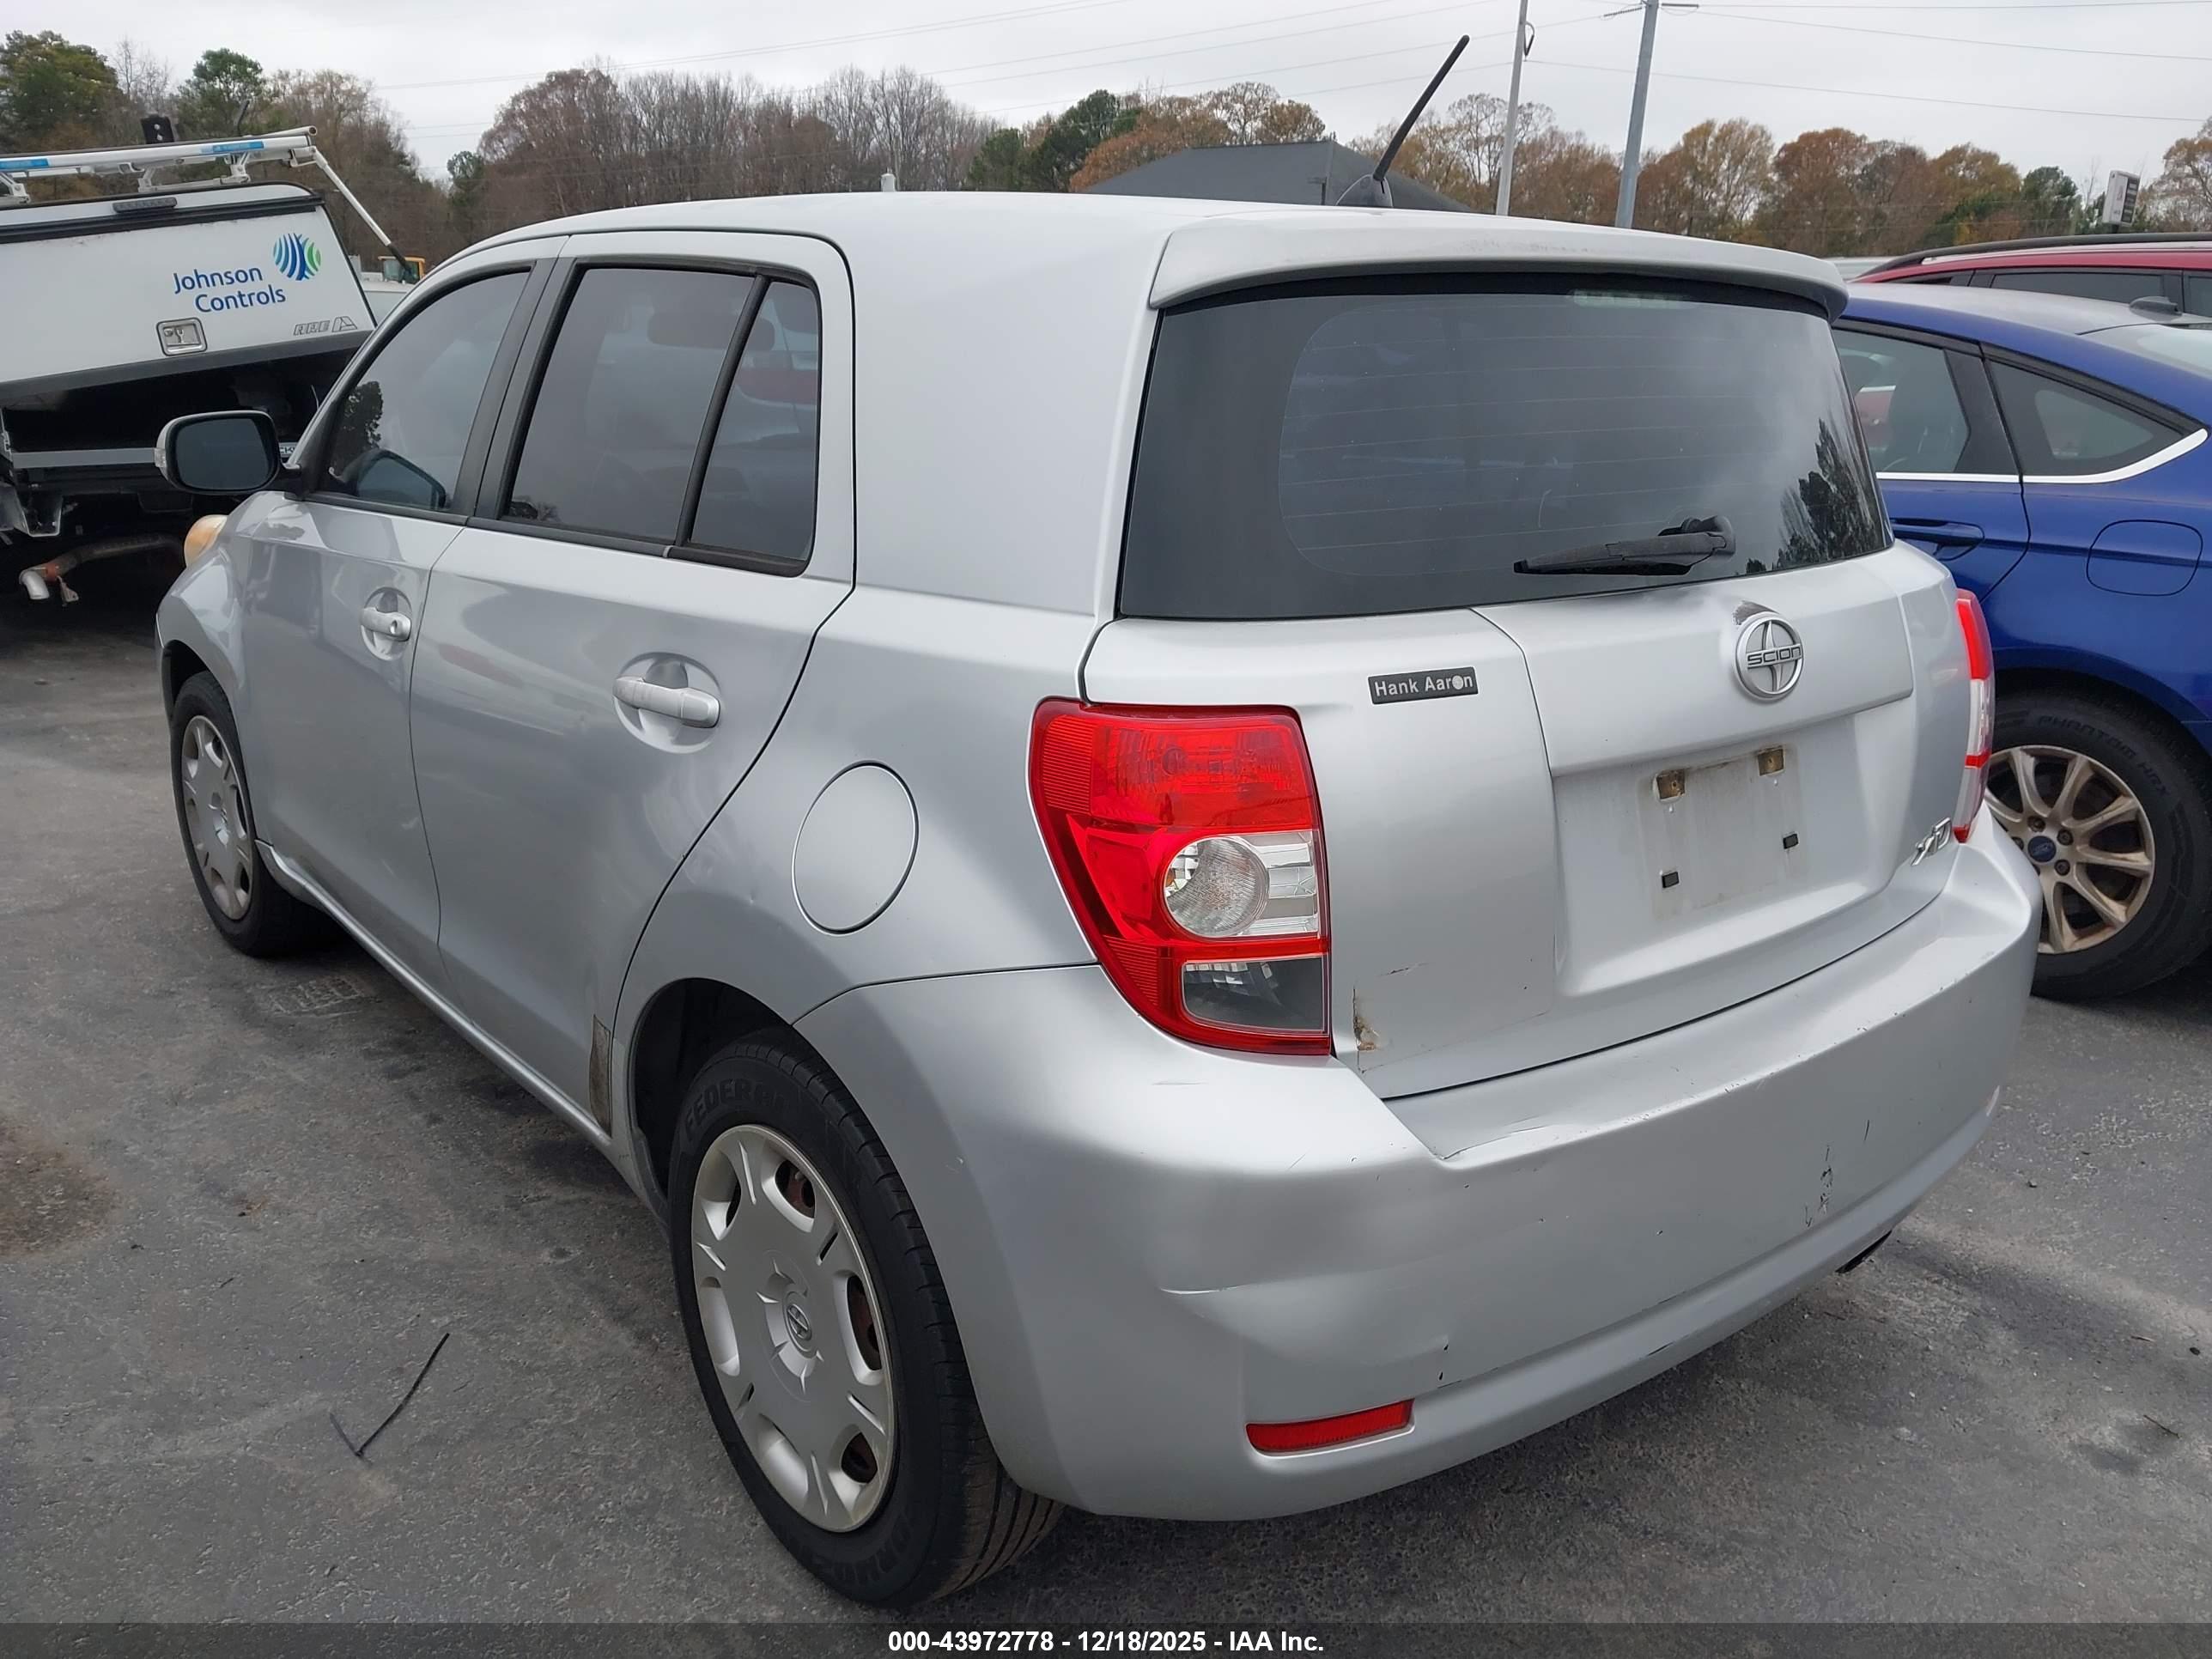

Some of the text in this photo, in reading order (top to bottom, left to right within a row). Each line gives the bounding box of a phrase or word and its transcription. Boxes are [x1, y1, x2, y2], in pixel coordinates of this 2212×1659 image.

[173, 267, 264, 294] Johnson
[195, 284, 287, 313] Controls
[1747, 646, 1802, 666] SCION
[1374, 674, 1474, 697] Hank Aaron
